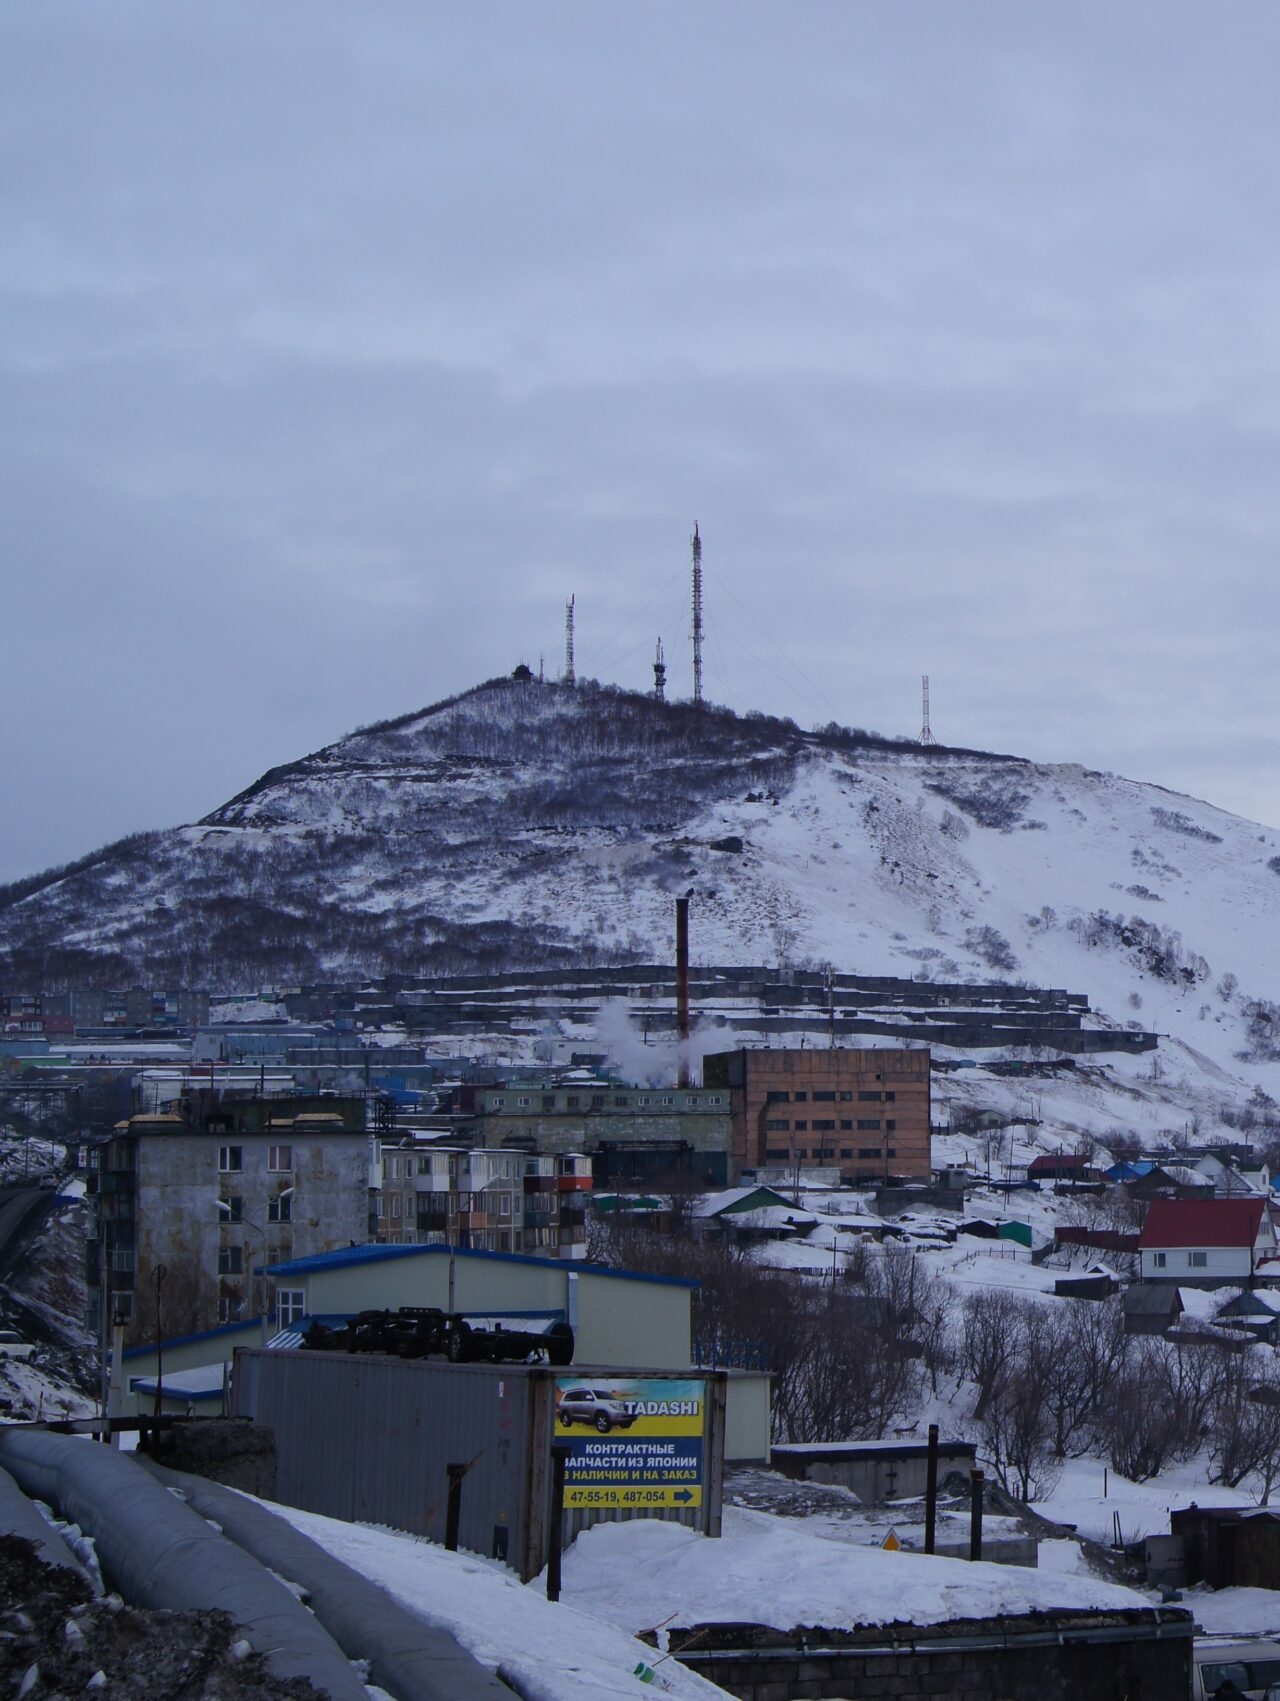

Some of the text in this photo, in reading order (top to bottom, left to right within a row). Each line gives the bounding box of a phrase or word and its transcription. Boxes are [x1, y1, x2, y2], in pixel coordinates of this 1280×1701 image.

[625, 1401, 698, 1415] TADASHI
[586, 1444, 675, 1454] КОНТРАКТНЫЕ
[629, 1457, 643, 1467] ИЗ
[647, 1457, 697, 1467] ЯПОНИИ
[573, 1470, 628, 1480] НАЛИЧИИ
[632, 1470, 640, 1480] И
[643, 1470, 659, 1480] НА
[662, 1470, 697, 1480] ЗАКАЗ
[571, 1491, 665, 1504] 47-55-19, 487-054
